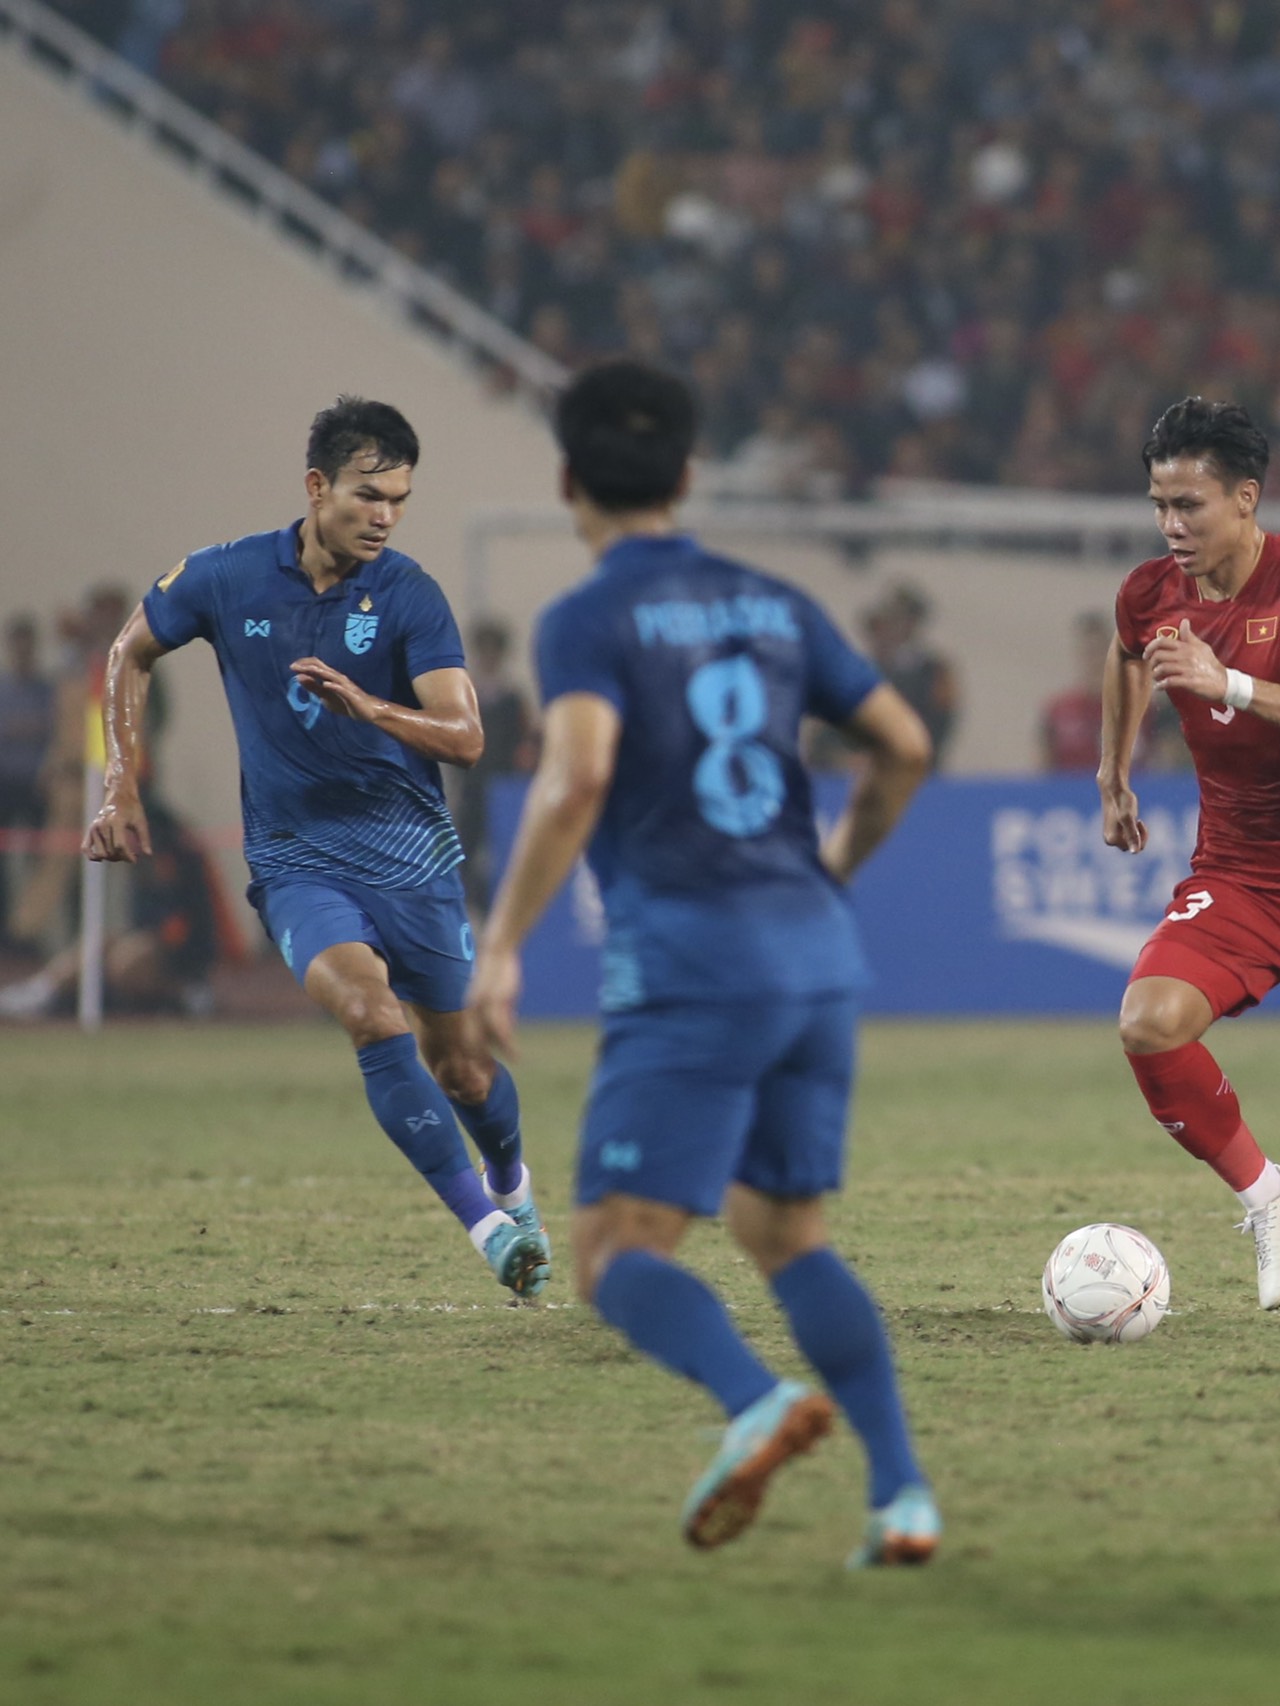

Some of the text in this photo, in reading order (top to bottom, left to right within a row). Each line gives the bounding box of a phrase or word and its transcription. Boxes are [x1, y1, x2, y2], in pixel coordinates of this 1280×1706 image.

[286, 674, 322, 731] 9
[688, 653, 786, 837] 8
[1167, 890, 1214, 922] 3
